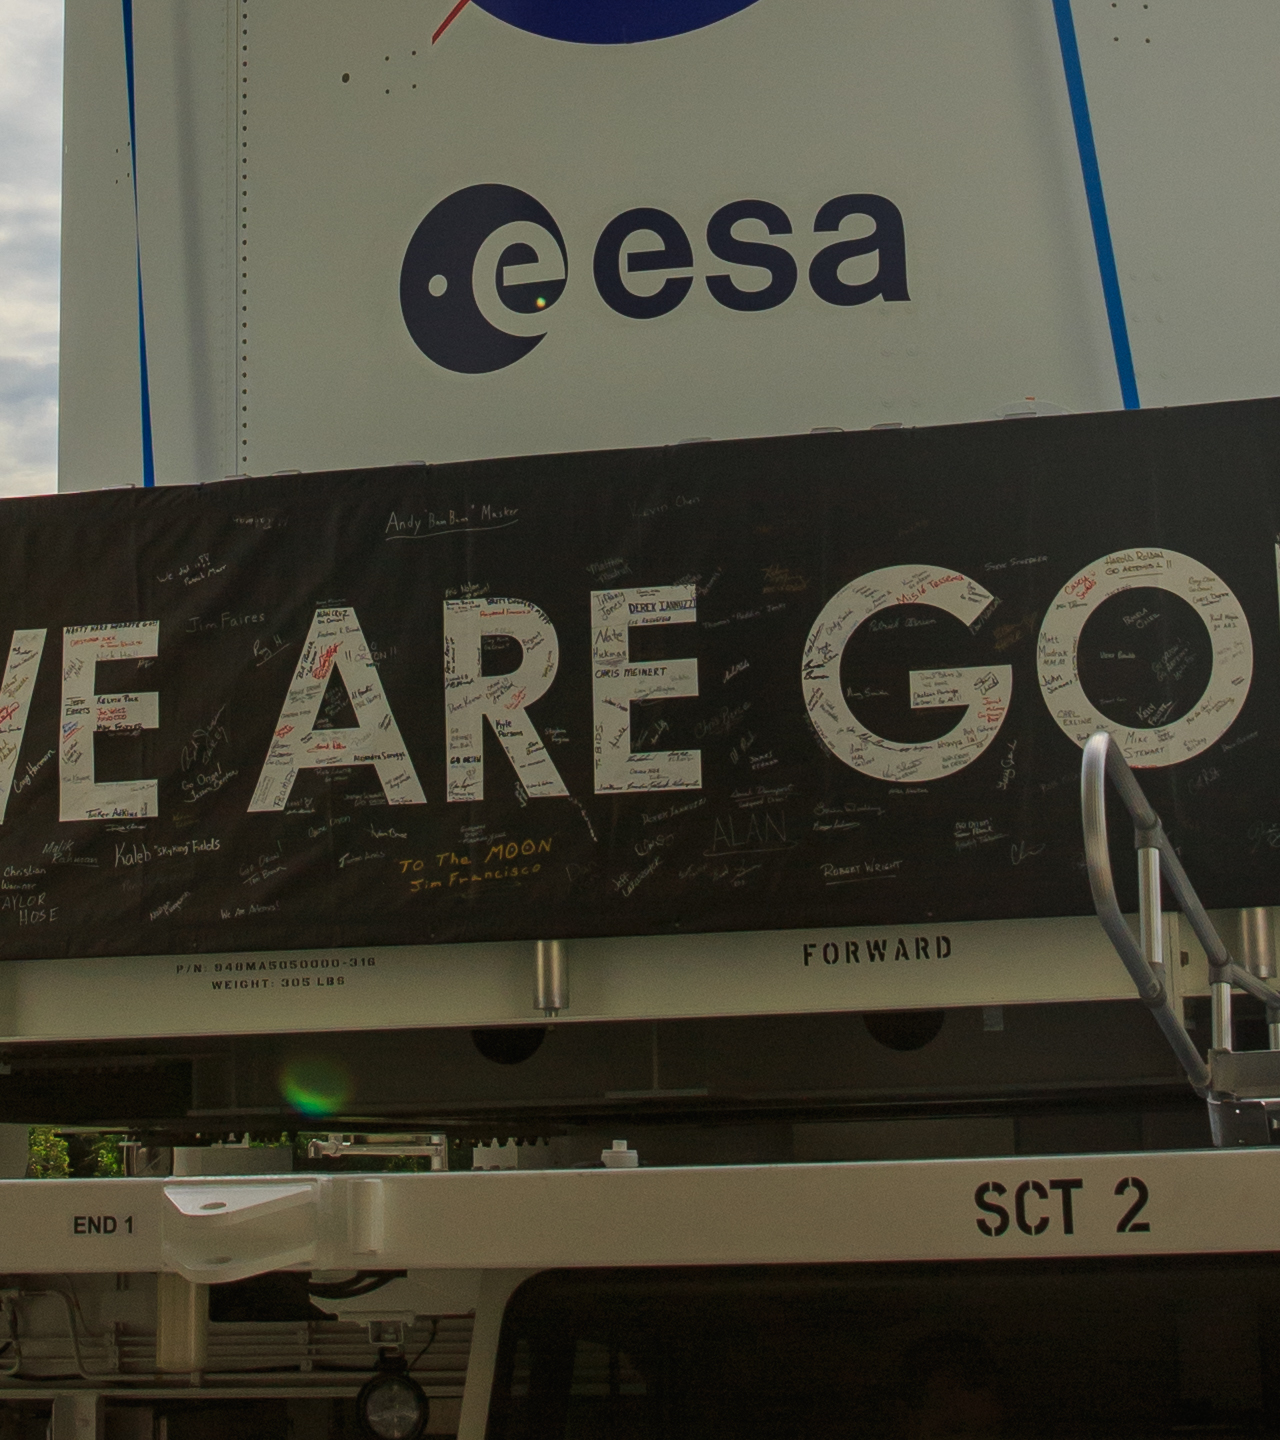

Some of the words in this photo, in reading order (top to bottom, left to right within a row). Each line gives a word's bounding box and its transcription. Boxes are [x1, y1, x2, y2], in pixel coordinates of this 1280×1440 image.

[592, 192, 913, 321] esa
[385, 511, 421, 534] Andy
[628, 602, 657, 615] DEREK
[594, 668, 620, 679] CHRIS
[623, 666, 668, 678] MEINERT
[246, 586, 702, 812] ARE
[1123, 746, 1166, 759] STEWART
[712, 810, 787, 851] ALAN
[114, 841, 152, 868] Kaleb
[191, 837, 221, 854] Fields
[399, 859, 424, 873] TO
[436, 852, 471, 867] The
[484, 838, 553, 863] MOON
[410, 878, 442, 892] Jim
[448, 863, 541, 888] Francisco
[820, 862, 861, 877] ROBERT
[863, 857, 904, 873] WRIGHT
[803, 935, 952, 966] FORWARD
[176, 964, 208, 974] P/N:
[211, 978, 275, 990] WEIGHT:
[280, 977, 311, 988] 305
[317, 976, 345, 987] LBS
[974, 1178, 1084, 1237] SCT
[1114, 1176, 1151, 1233] 2
[73, 1215, 118, 1234] END
[124, 1215, 133, 1234] 1
